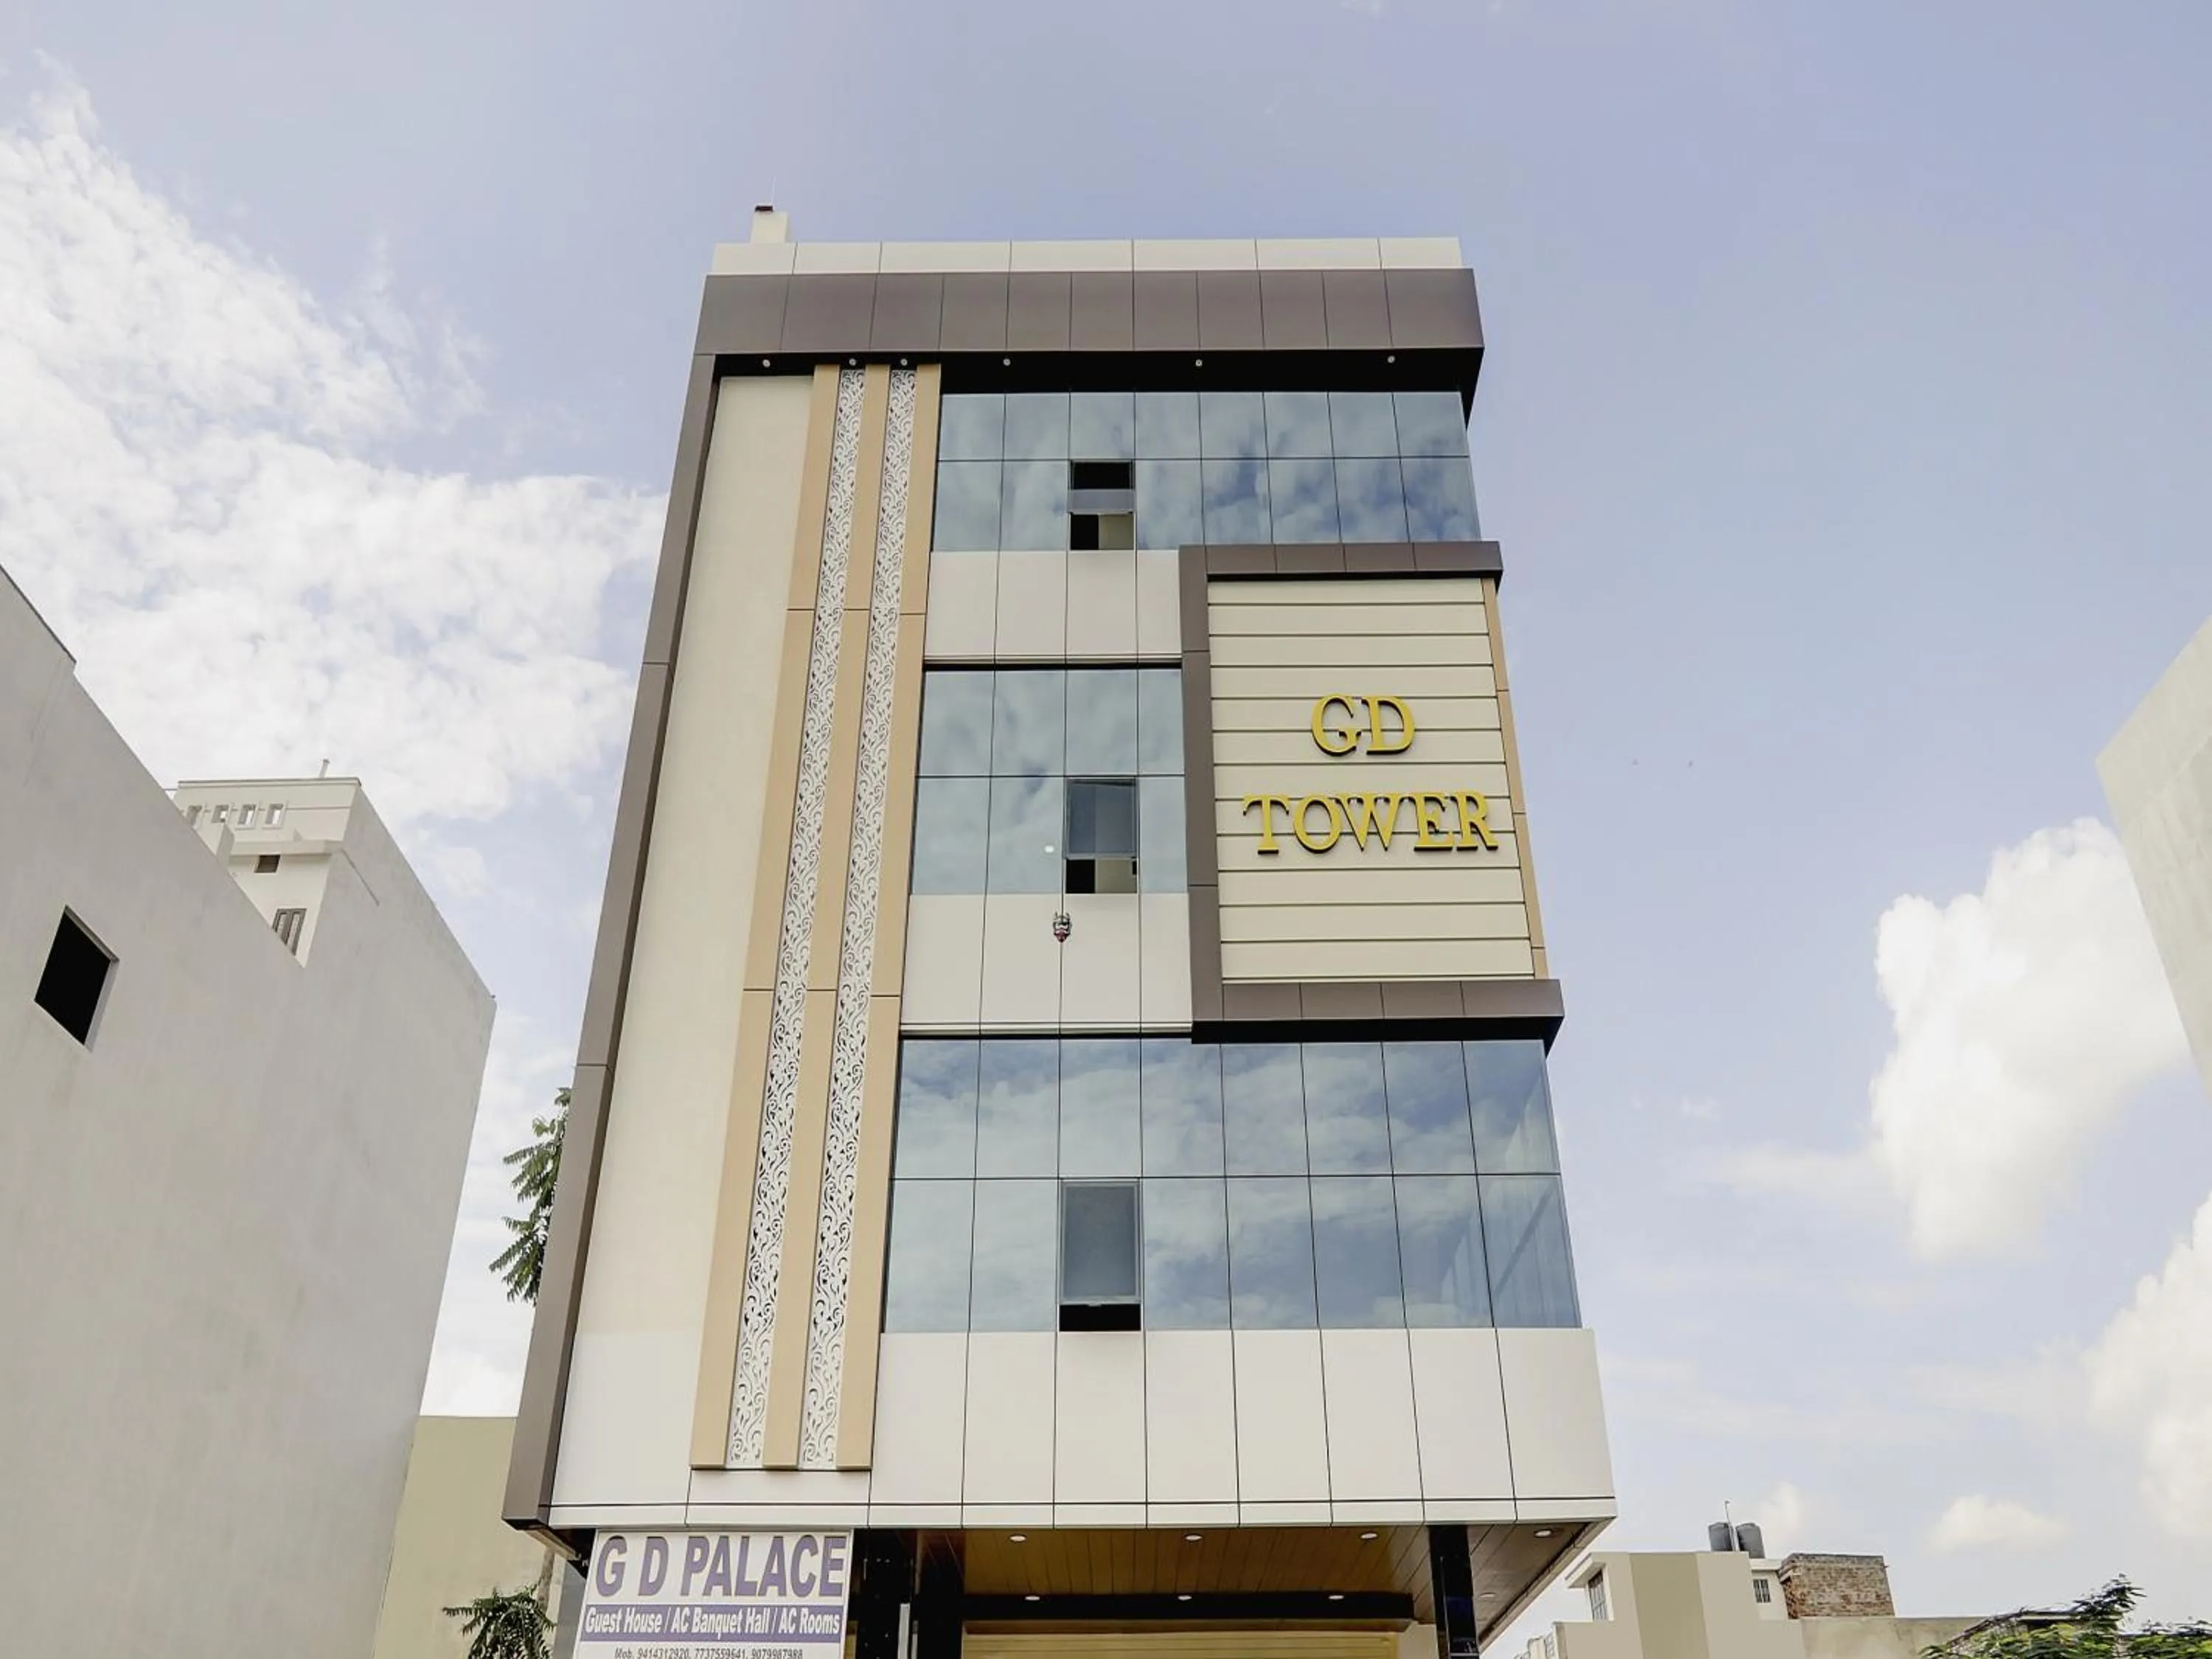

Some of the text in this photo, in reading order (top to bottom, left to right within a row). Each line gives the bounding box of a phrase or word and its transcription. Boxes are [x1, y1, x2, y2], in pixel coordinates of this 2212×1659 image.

[1311, 693, 1415, 757] GD
[1242, 790, 1498, 855] TOWER
[595, 1534, 848, 1598] G D PALACE
[585, 1607, 622, 1633] Guest
[623, 1607, 663, 1633] House
[670, 1607, 690, 1633] AC
[691, 1607, 743, 1640] Banquet
[745, 1607, 771, 1634] Hall
[778, 1607, 797, 1634] AC
[799, 1607, 840, 1635] Rooms
